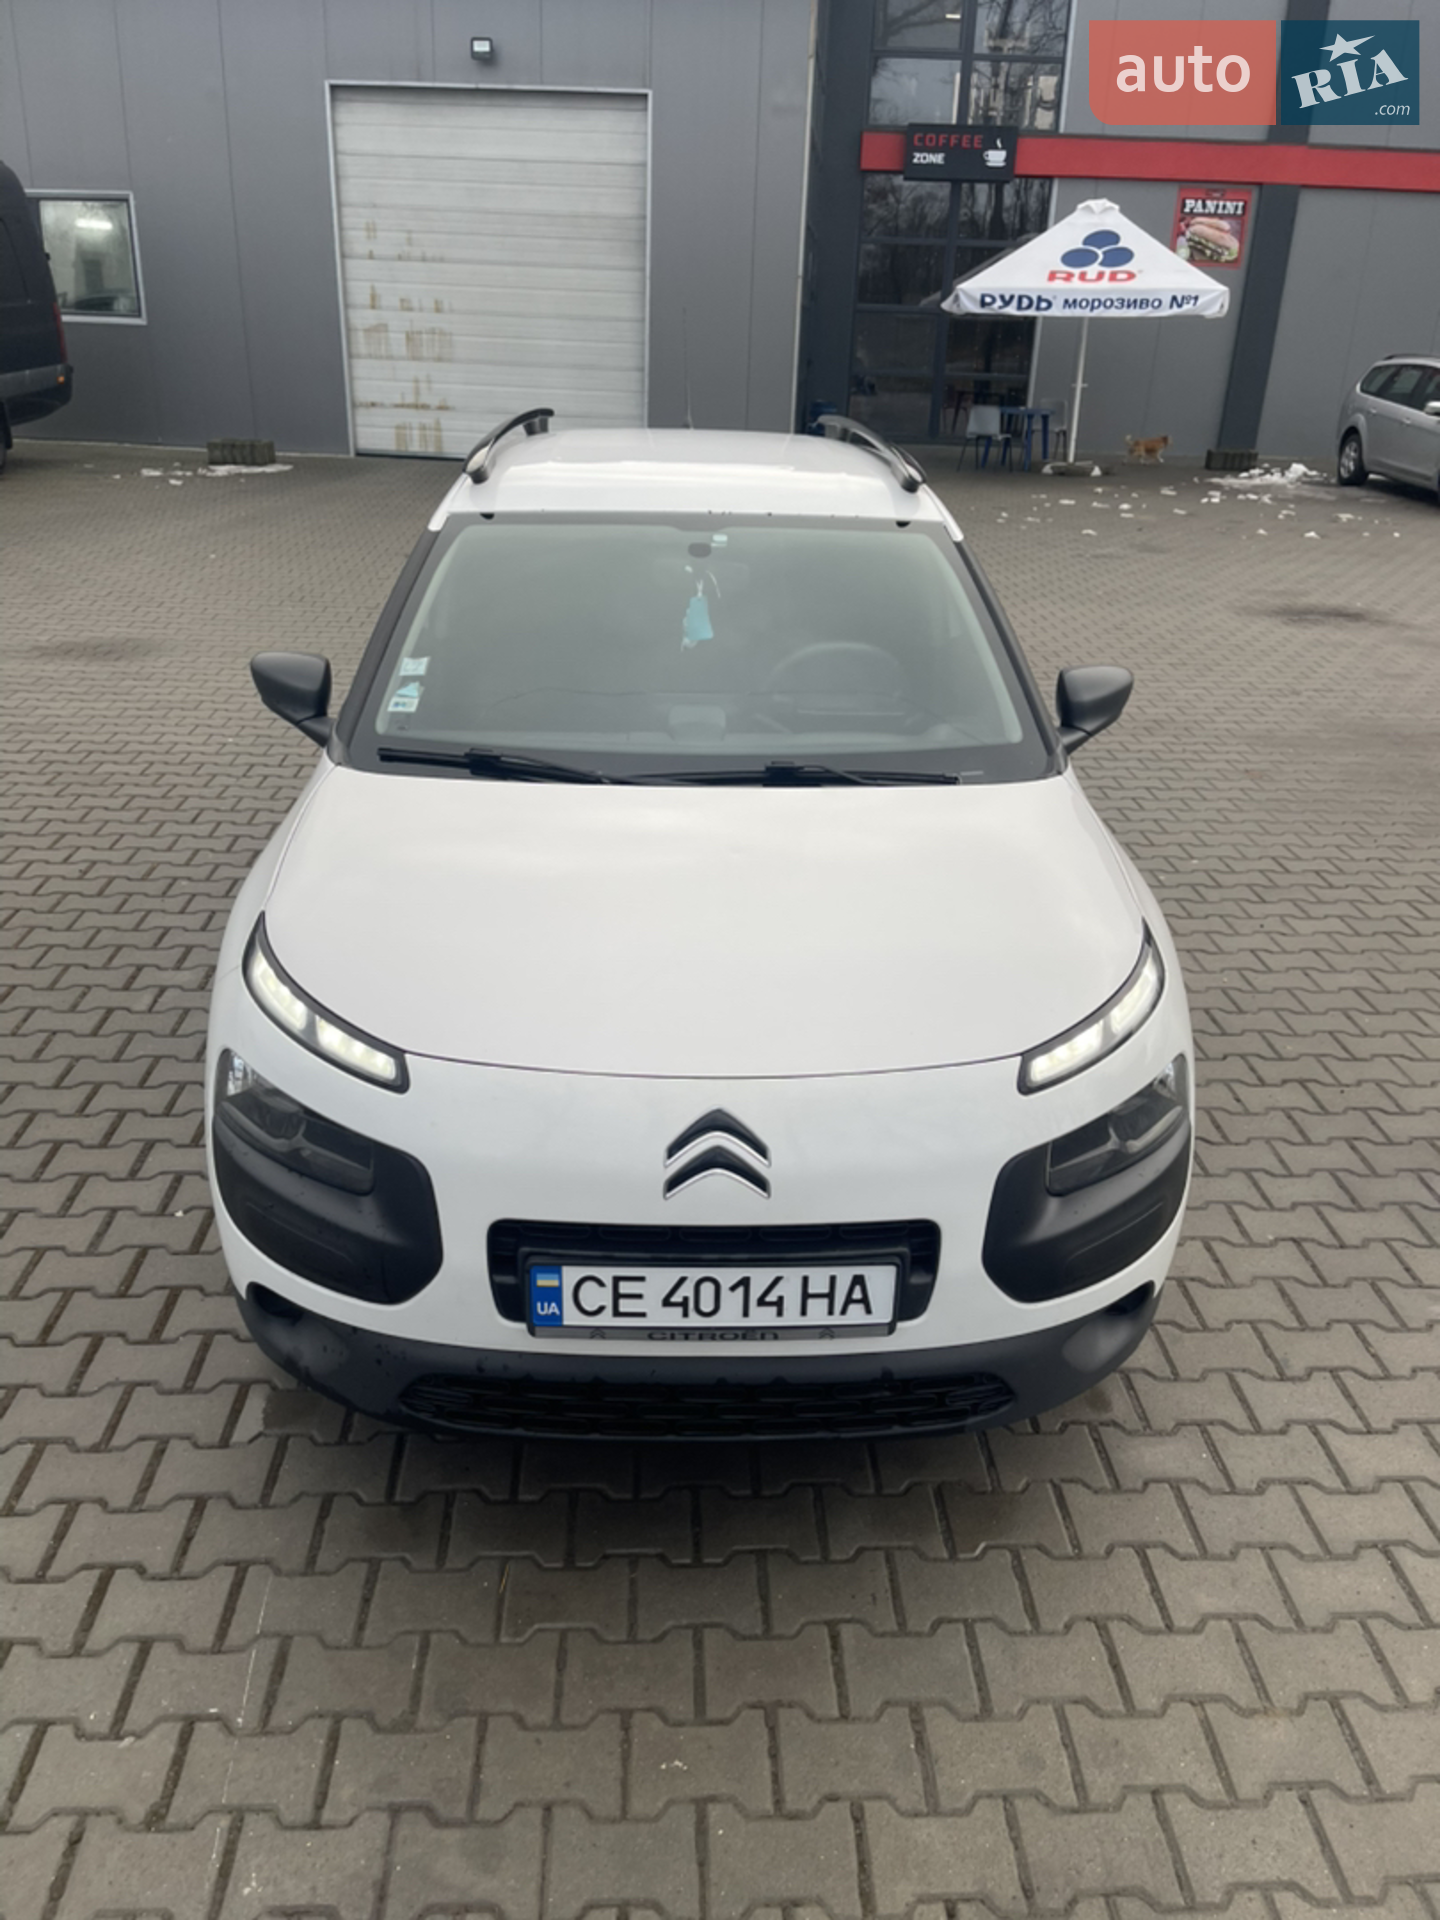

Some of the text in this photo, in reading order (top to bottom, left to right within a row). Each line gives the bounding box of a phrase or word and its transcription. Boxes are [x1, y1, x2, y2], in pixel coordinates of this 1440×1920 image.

[913, 133, 983, 149] COFFEE
[912, 152, 945, 165] ZONE
[1183, 198, 1245, 215] PANINI
[1047, 270, 1136, 283] RUD
[1062, 298, 1162, 312] морозиво
[572, 1274, 873, 1318] CE 4014 HA
[536, 1302, 560, 1316] UA
